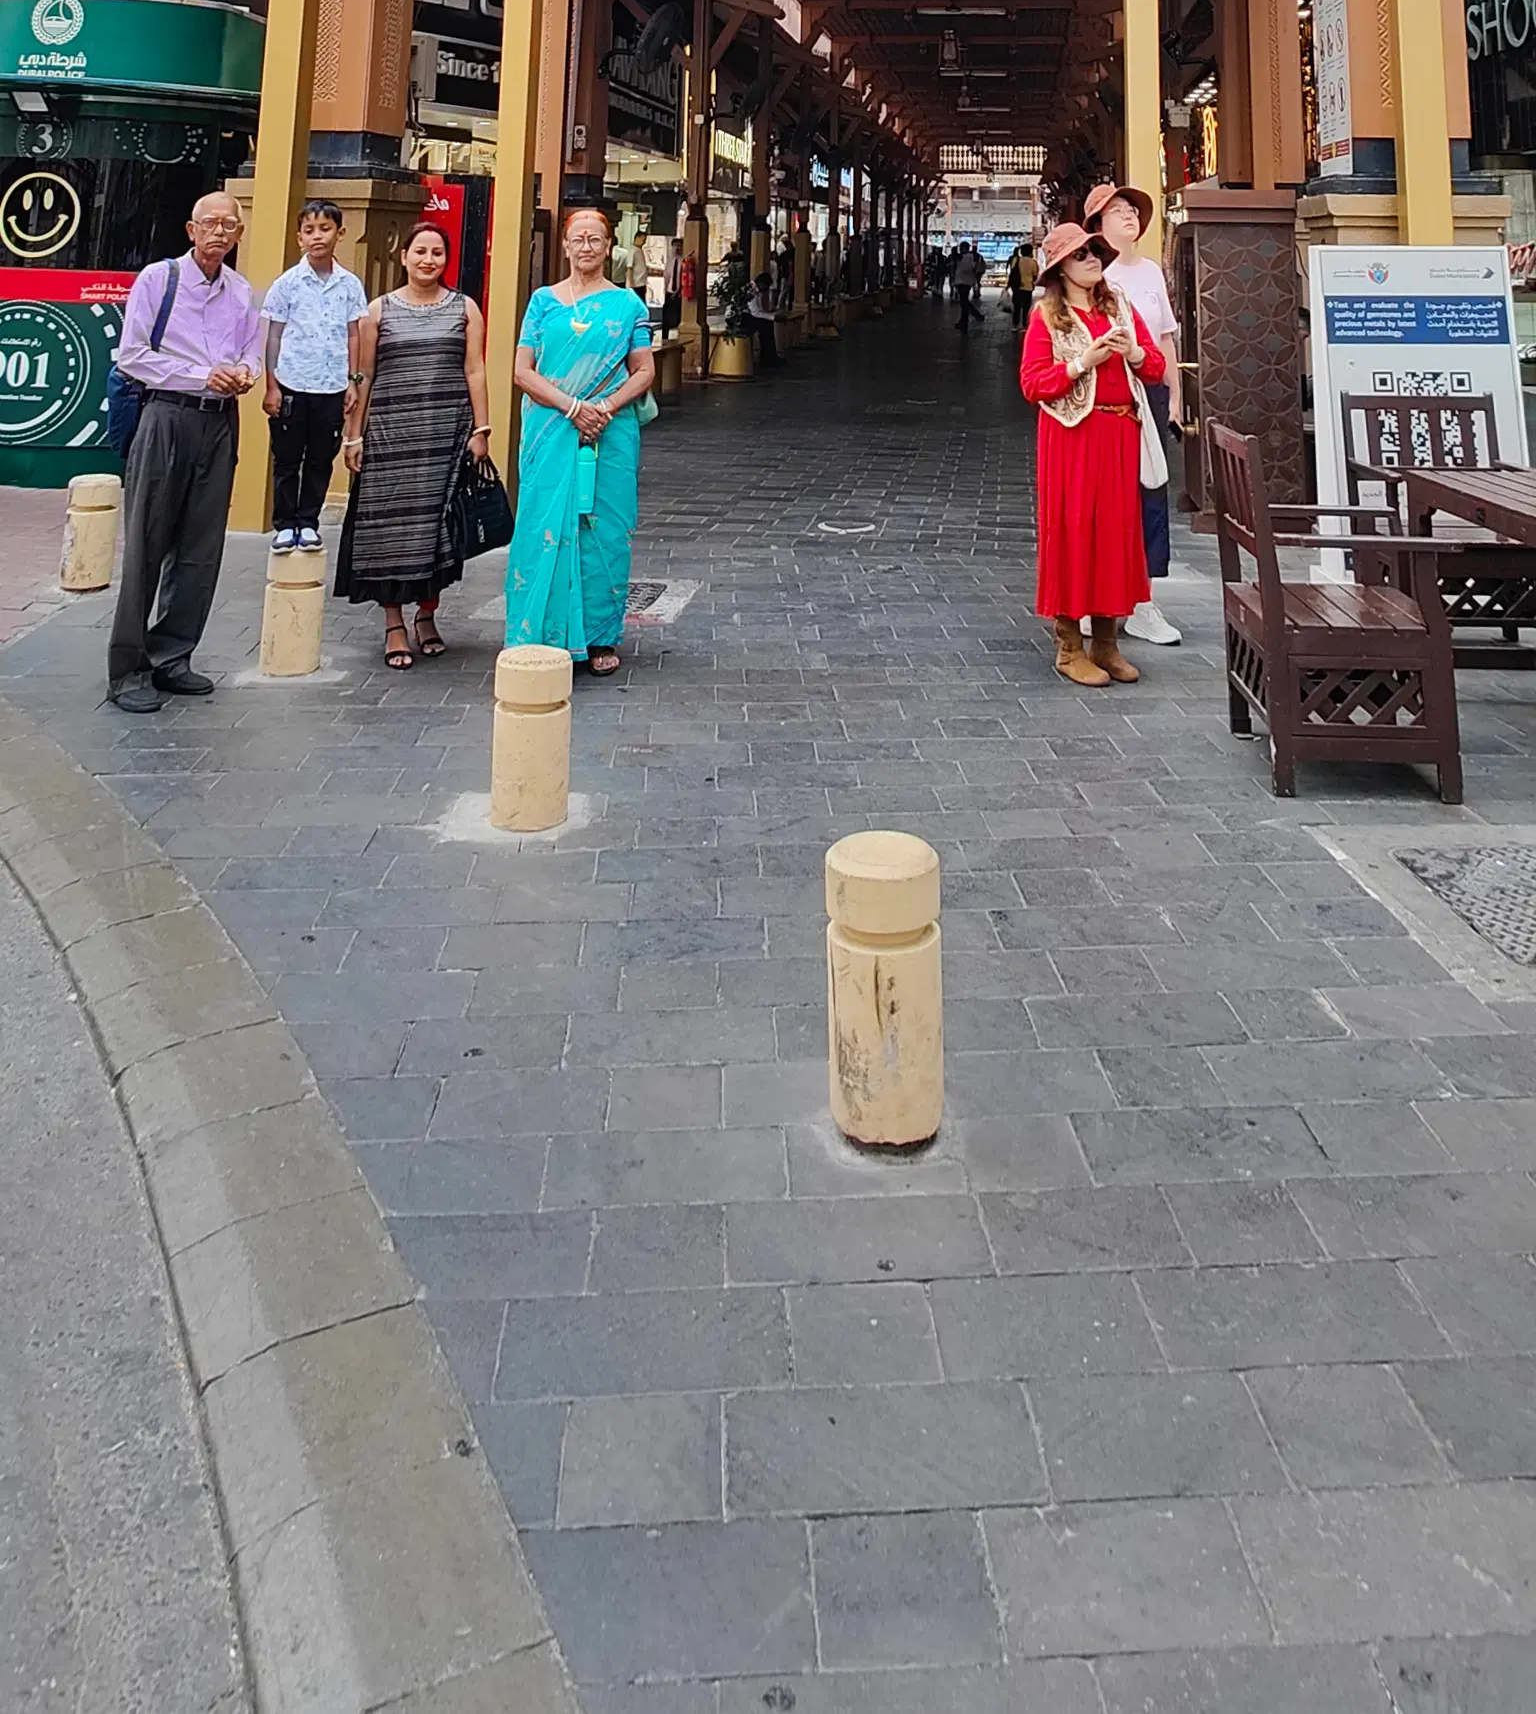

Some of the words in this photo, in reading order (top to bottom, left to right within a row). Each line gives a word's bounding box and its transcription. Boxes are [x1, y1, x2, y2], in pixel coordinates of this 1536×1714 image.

[47, 51, 87, 70] شرطة
[437, 50, 489, 81] Since
[31, 123, 53, 154] 3
[1334, 301, 1348, 309] Test
[1353, 301, 1366, 309] and
[1371, 301, 1398, 309] evaluate
[1403, 301, 1415, 309] the
[1334, 310, 1356, 319] quality
[1357, 310, 1365, 318] of
[1403, 310, 1416, 318] and
[1334, 319, 1362, 328] precious
[1364, 319, 1386, 327] metals
[1387, 319, 1396, 328] by
[0, 350, 50, 388] 01
